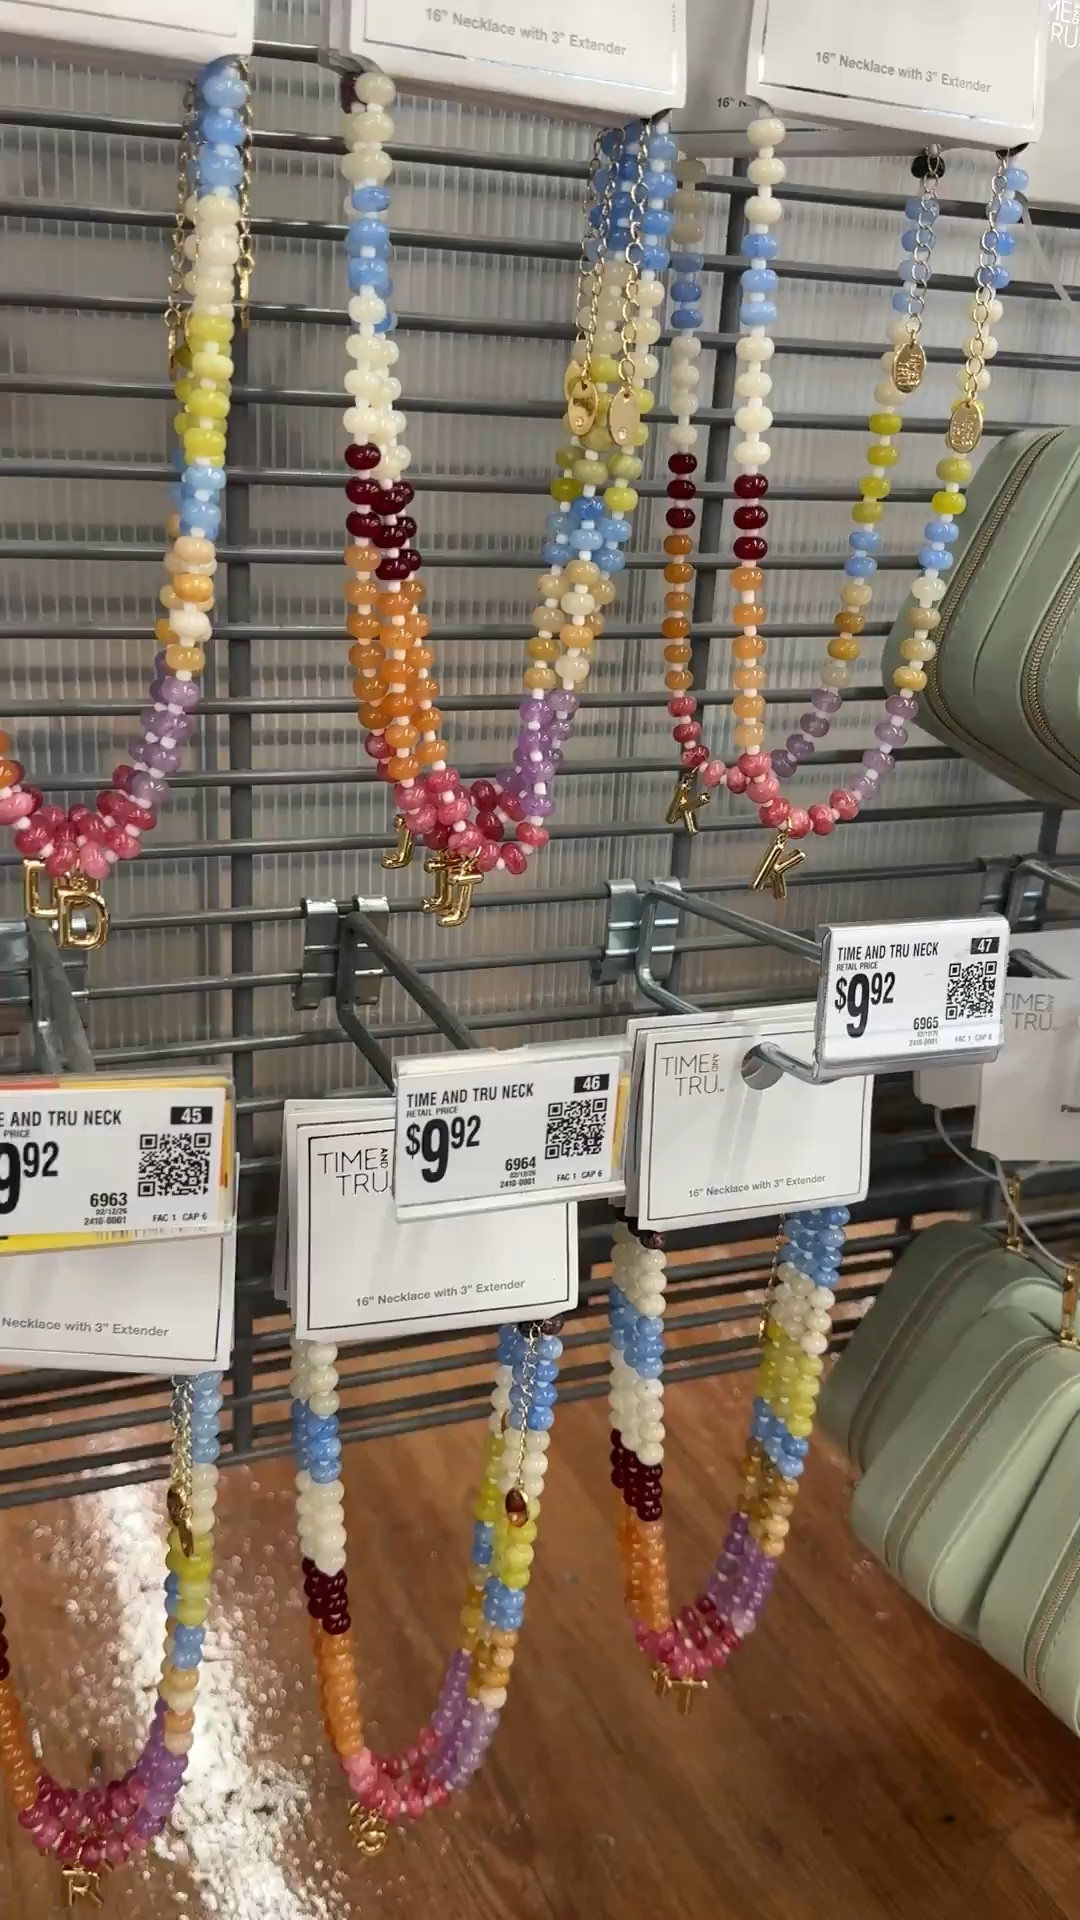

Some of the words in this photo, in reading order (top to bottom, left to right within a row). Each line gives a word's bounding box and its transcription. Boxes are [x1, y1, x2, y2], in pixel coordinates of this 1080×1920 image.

[425, 8, 450, 22] 16"
[452, 14, 516, 36] Necklace
[520, 25, 548, 42] with
[551, 29, 566, 44] 3"
[569, 34, 627, 57] Extender
[1048, 22, 1078, 48] RU
[815, 51, 836, 65] 16"
[839, 55, 895, 76] Necklace
[898, 66, 923, 81] with
[925, 70, 938, 83] 3"
[941, 73, 992, 94] Extender
[837, 946, 863, 961] TIME
[864, 944, 886, 960] AND
[890, 943, 910, 958] TRU
[912, 941, 939, 957] NECK
[977, 939, 993, 953] 47
[836, 963, 858, 971] RETAIL
[860, 961, 878, 969] PRICE
[913, 1016, 939, 1030] 6965
[660, 1054, 711, 1076] TIME
[582, 1075, 601, 1090] 46
[406, 1092, 437, 1108] TIME
[441, 1089, 468, 1105] AND
[473, 1086, 498, 1102] TRU
[502, 1083, 534, 1099] NECK
[10, 1111, 42, 1127] AND
[48, 1110, 78, 1126] TRU
[84, 1109, 122, 1125] NECK
[181, 1108, 202, 1123] 45
[406, 1108, 432, 1118] RETAIL
[435, 1106, 458, 1115] PRICE
[317, 1148, 378, 1174] TIME
[380, 1148, 389, 1169] AND
[505, 1156, 536, 1171] 6964
[336, 1171, 389, 1196] TRU
[581, 1170, 596, 1178] CAP
[688, 1187, 705, 1198] 16"
[706, 1183, 750, 1197] Necklace
[751, 1180, 772, 1191] with
[773, 1178, 785, 1189] 3"
[786, 1174, 827, 1187] Extender
[90, 1192, 128, 1207] 6963
[152, 1214, 168, 1222] FAC
[182, 1212, 199, 1221] CAP
[202, 1212, 207, 1220] 6
[355, 1295, 375, 1307] 16"
[378, 1289, 431, 1305] Necklace
[434, 1286, 458, 1298] with
[460, 1284, 473, 1296] 3"
[475, 1278, 526, 1294] Extender
[1, 1317, 61, 1331] Necklace
[64, 1321, 91, 1333] with
[94, 1322, 109, 1333] 3"
[113, 1324, 169, 1337] Extender
